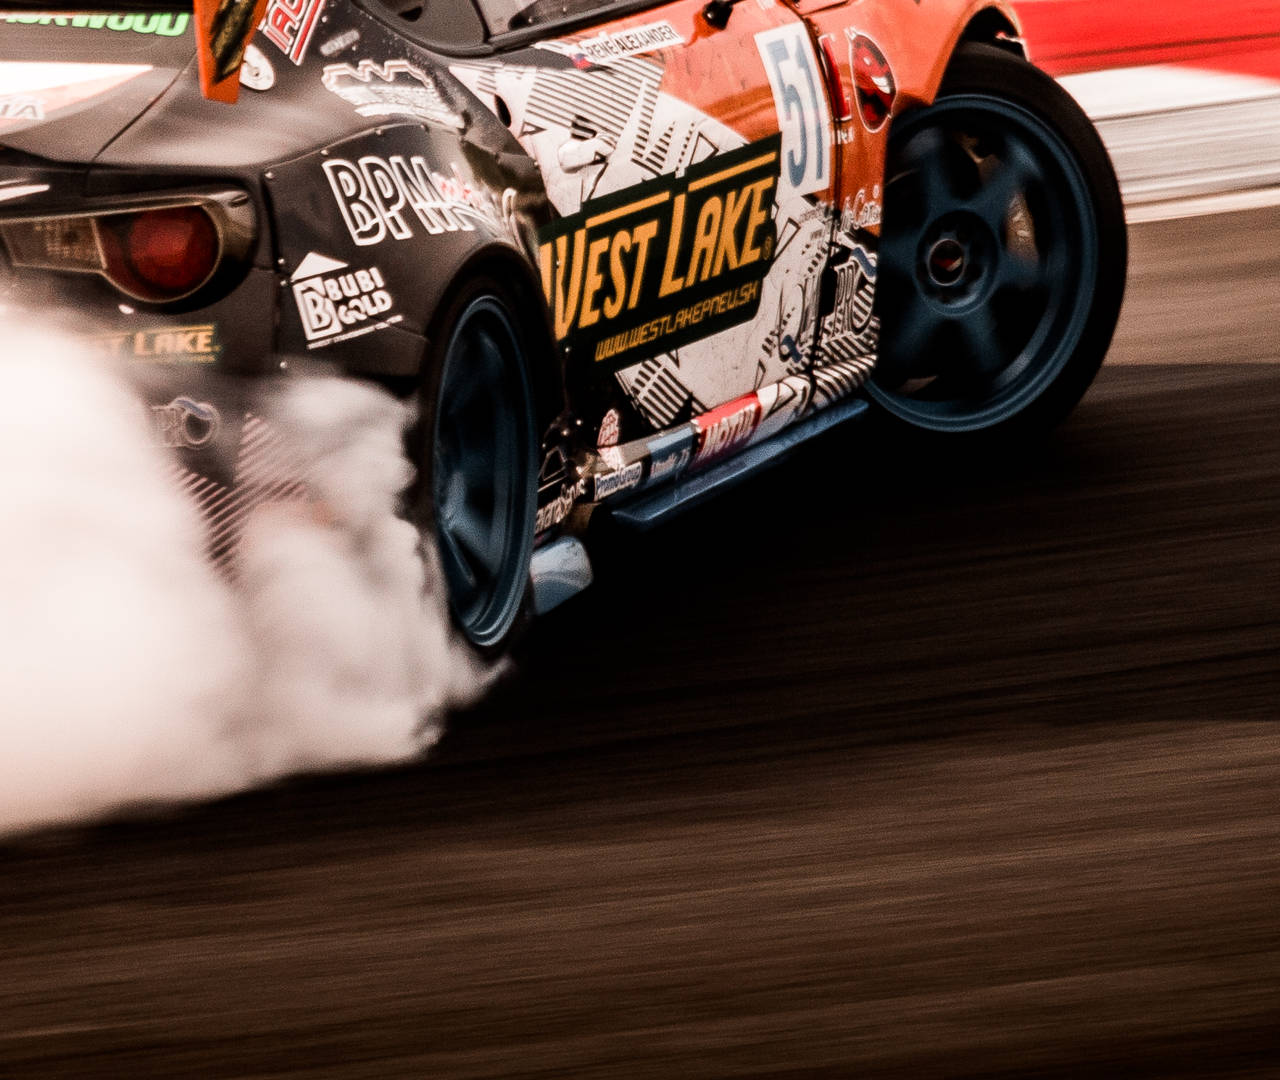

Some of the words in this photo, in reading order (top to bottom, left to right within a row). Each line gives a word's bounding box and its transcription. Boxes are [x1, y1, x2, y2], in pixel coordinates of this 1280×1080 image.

[766, 34, 823, 188] 51
[321, 156, 475, 247] BPM
[324, 266, 385, 302] BUBI
[539, 219, 659, 342] WEST
[658, 175, 775, 299] LAKE
[337, 290, 394, 325] GOLD
